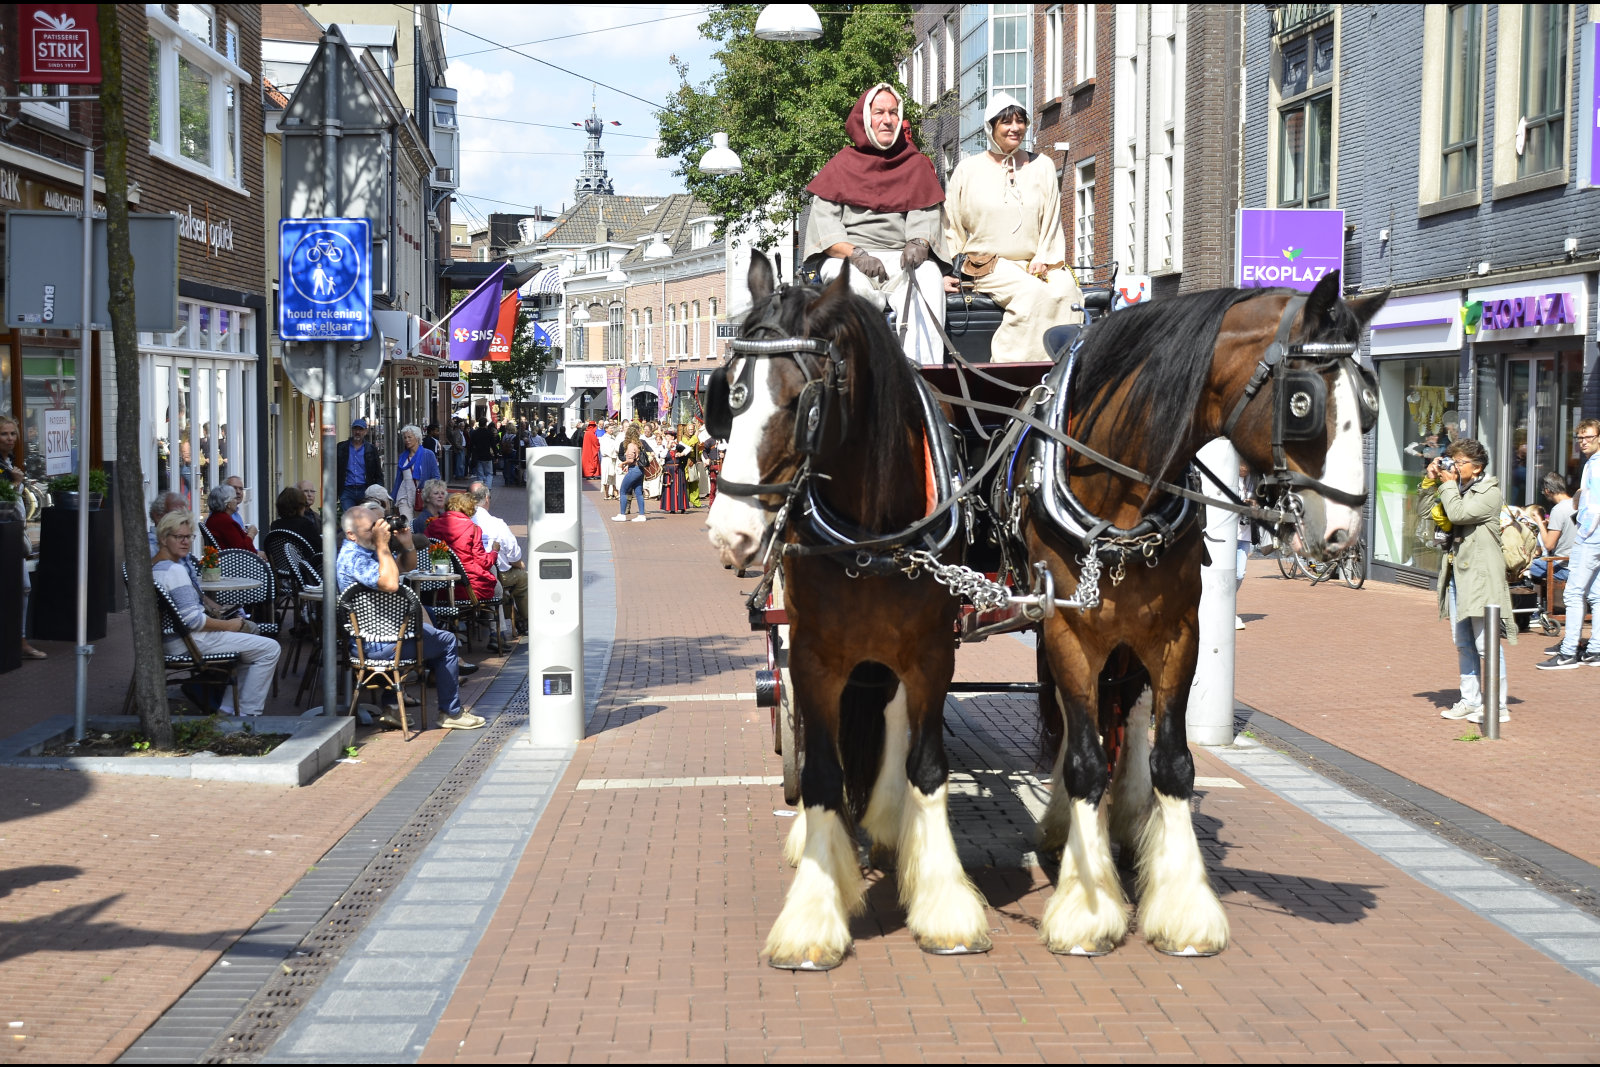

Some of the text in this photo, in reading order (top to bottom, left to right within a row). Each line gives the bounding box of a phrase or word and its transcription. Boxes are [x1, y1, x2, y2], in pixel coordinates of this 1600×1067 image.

[38, 42, 84, 58] STRIK
[43, 285, 55, 321] BUKO
[287, 308, 362, 321] houd rekening
[1482, 293, 1575, 331] EKOPLAZA
[296, 322, 353, 331] met elkaar
[470, 329, 494, 343] SNS
[491, 335, 502, 345] ts
[489, 344, 509, 353] ace
[47, 430, 70, 454] STRIK
